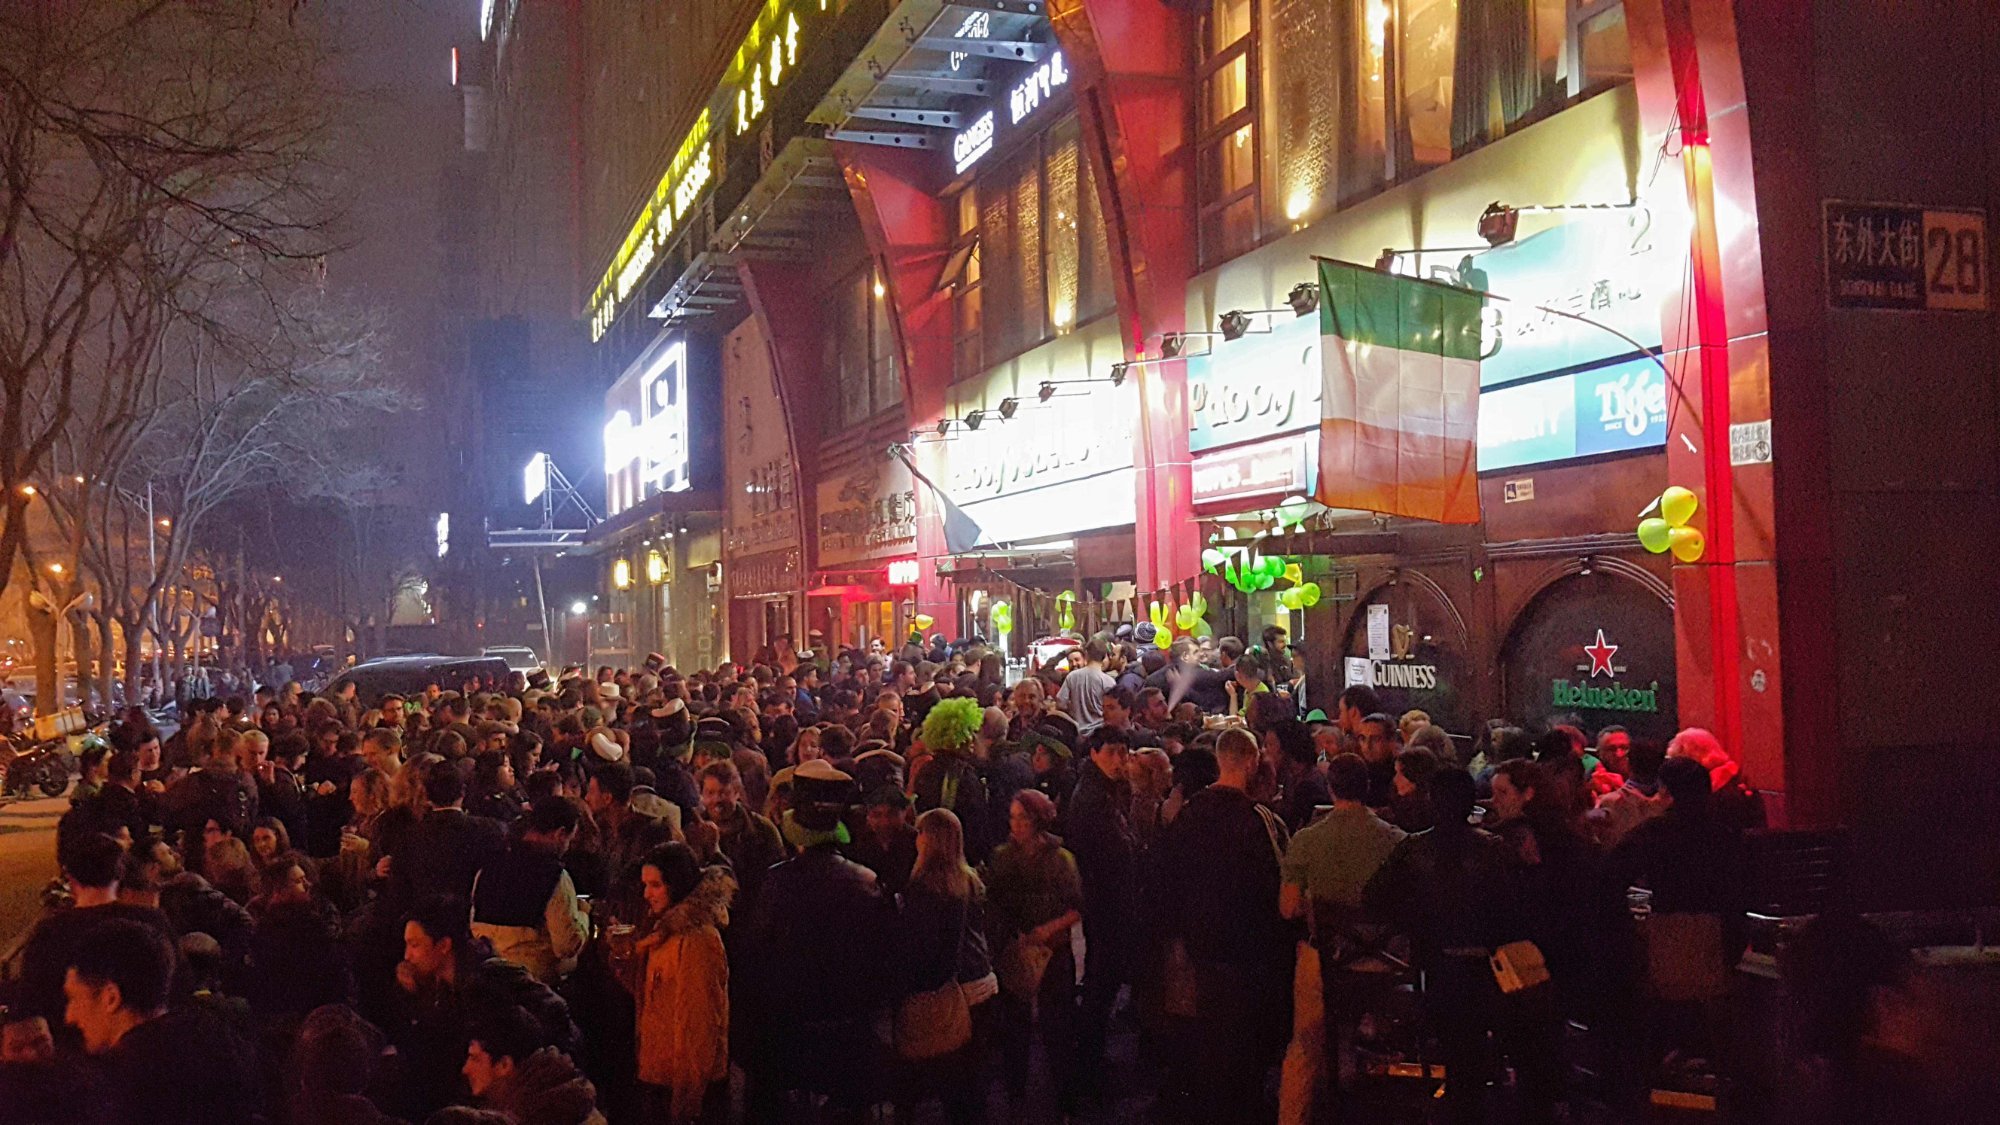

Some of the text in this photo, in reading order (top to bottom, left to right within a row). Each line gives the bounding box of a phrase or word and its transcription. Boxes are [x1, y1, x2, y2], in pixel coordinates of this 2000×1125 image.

[954, 110, 994, 162] GANGES
[1831, 213, 1920, 269] 东外大街
[1927, 226, 1981, 295] 28
[1595, 370, 1666, 436] Tige
[1371, 659, 1437, 690] GUINNESS
[1552, 679, 1658, 713] Heineken
